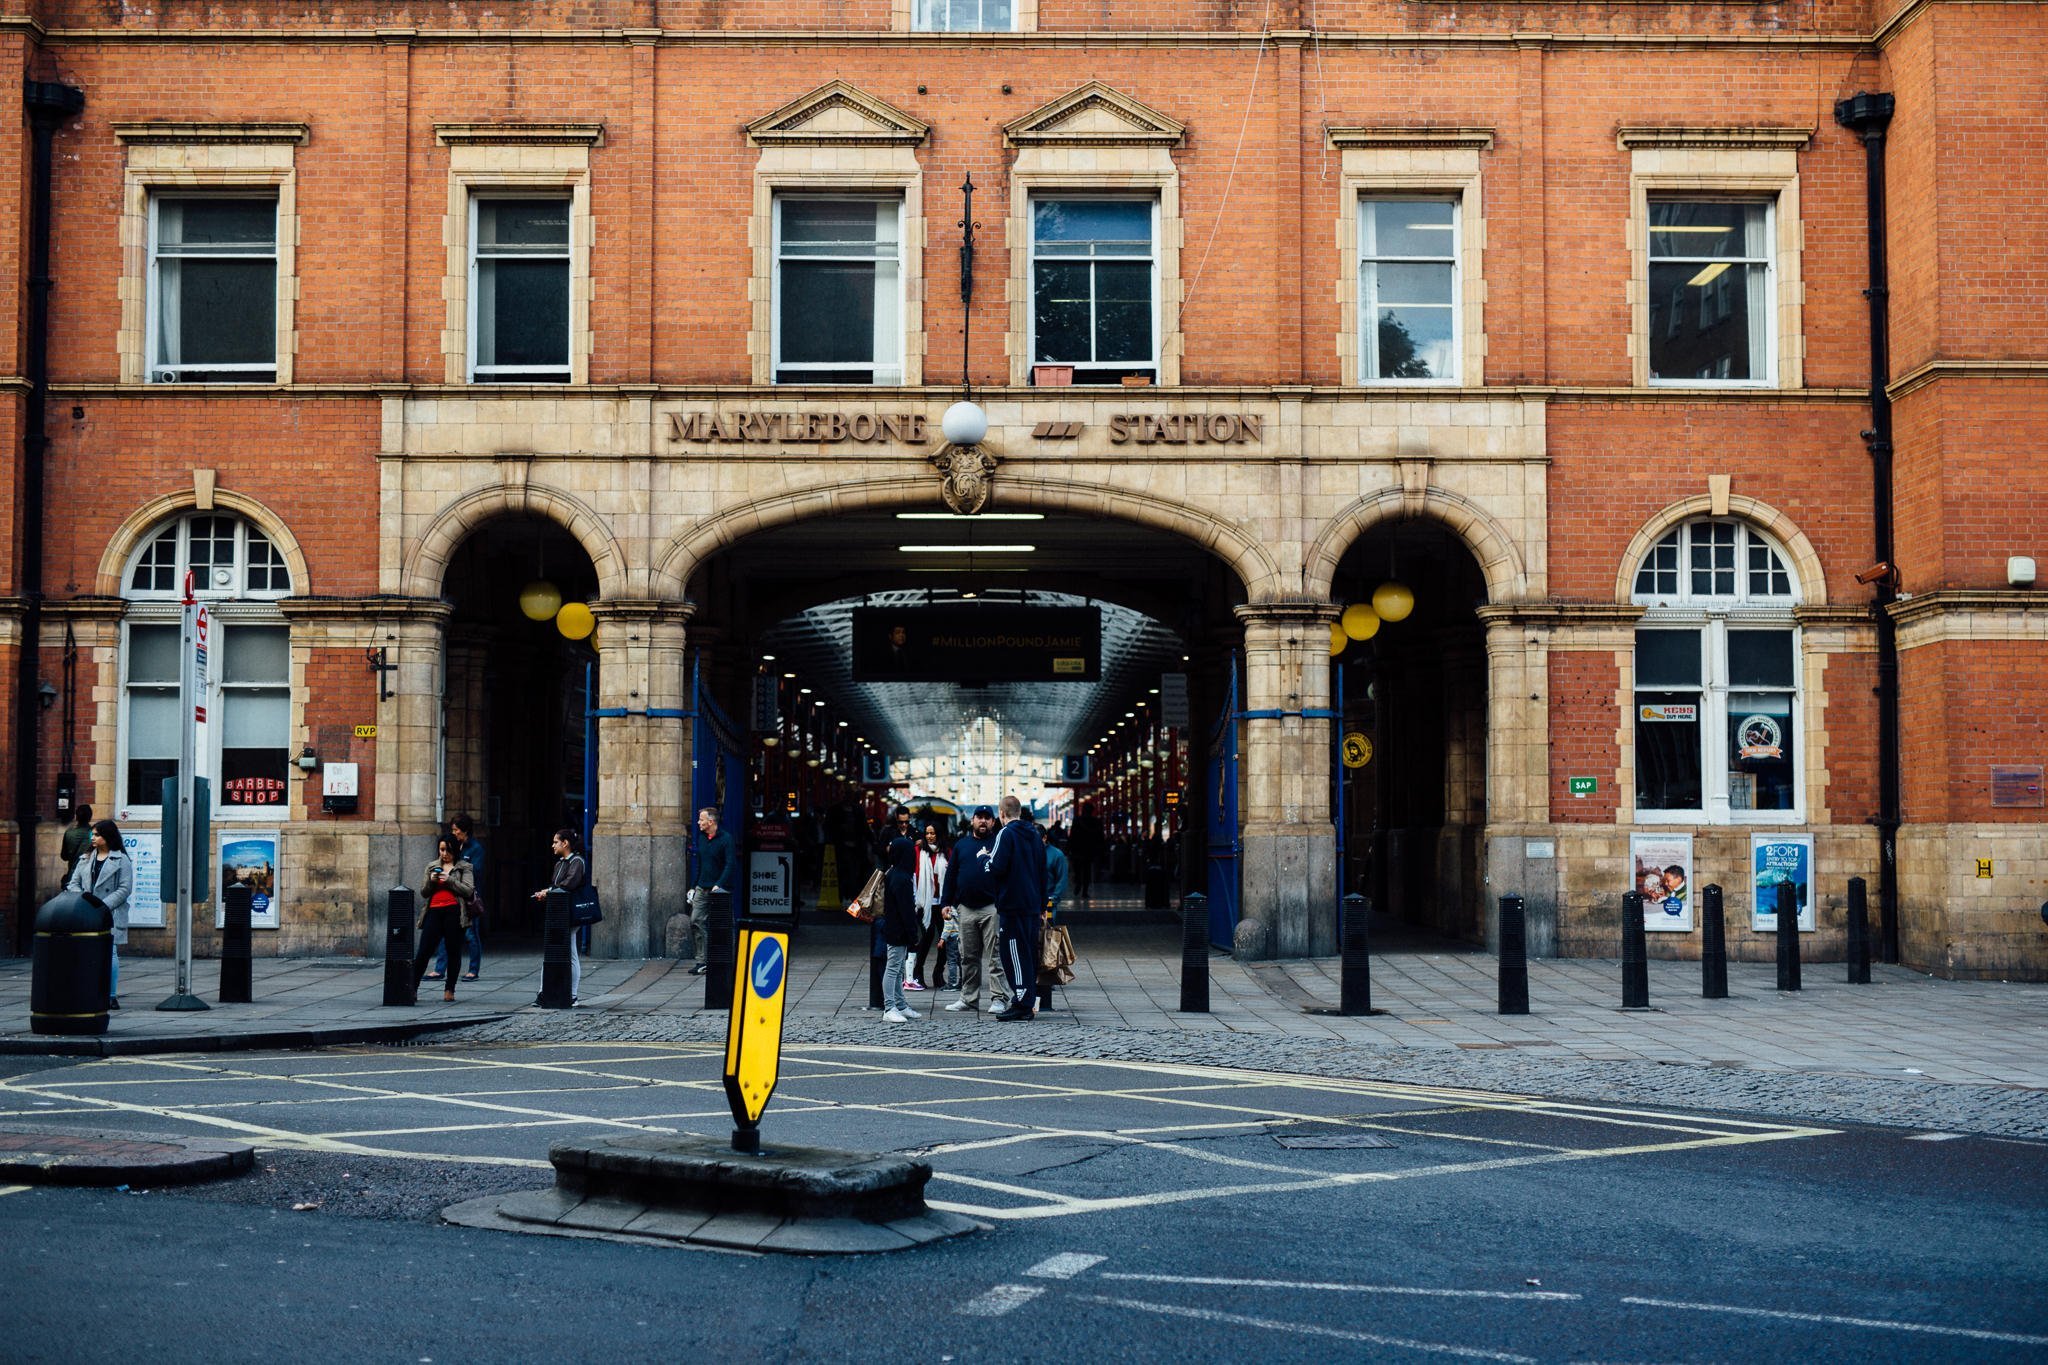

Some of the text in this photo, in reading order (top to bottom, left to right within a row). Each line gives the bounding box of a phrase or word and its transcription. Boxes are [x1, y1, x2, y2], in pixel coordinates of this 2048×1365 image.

[670, 412, 1263, 443] MARYLEBONE STATION
[356, 727, 376, 735] RVP
[872, 761, 881, 775] 3
[1071, 760, 1080, 775] 2
[225, 778, 286, 791] BARBER
[1575, 781, 1592, 790] SAP
[232, 791, 279, 804] SHOP
[752, 871, 777, 880] SHOE
[752, 884, 779, 893] SHINE
[751, 897, 790, 907] SERVICE
